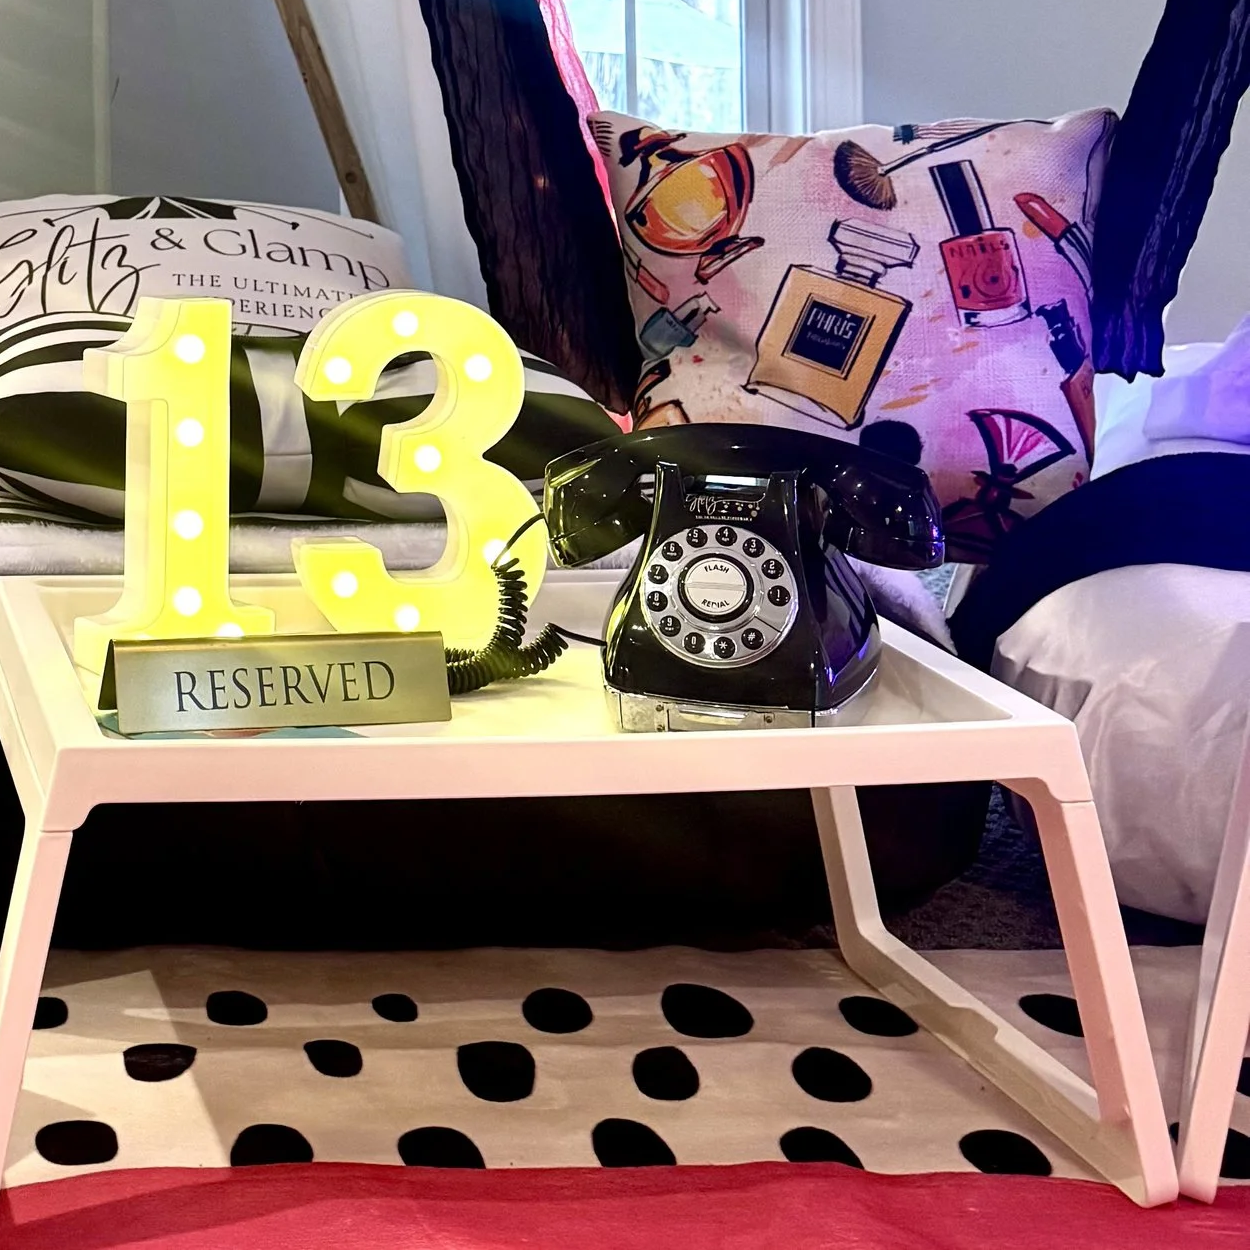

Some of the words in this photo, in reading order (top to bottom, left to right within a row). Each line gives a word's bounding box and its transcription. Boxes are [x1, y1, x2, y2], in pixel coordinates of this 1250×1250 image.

[149, 226, 187, 252] &
[202, 227, 390, 291] Glamp
[172, 272, 223, 289] THE
[74, 289, 549, 660] 13
[692, 529, 699, 538] 5
[723, 528, 729, 537] 4
[669, 542, 675, 552] 6
[750, 539, 756, 548] 3
[704, 564, 730, 574] FLASH
[769, 560, 775, 570] 2
[653, 592, 660, 602] 8
[666, 617, 673, 627] 9
[690, 635, 697, 645] 0
[747, 632, 756, 641] #
[173, 659, 397, 713] RESERVED
